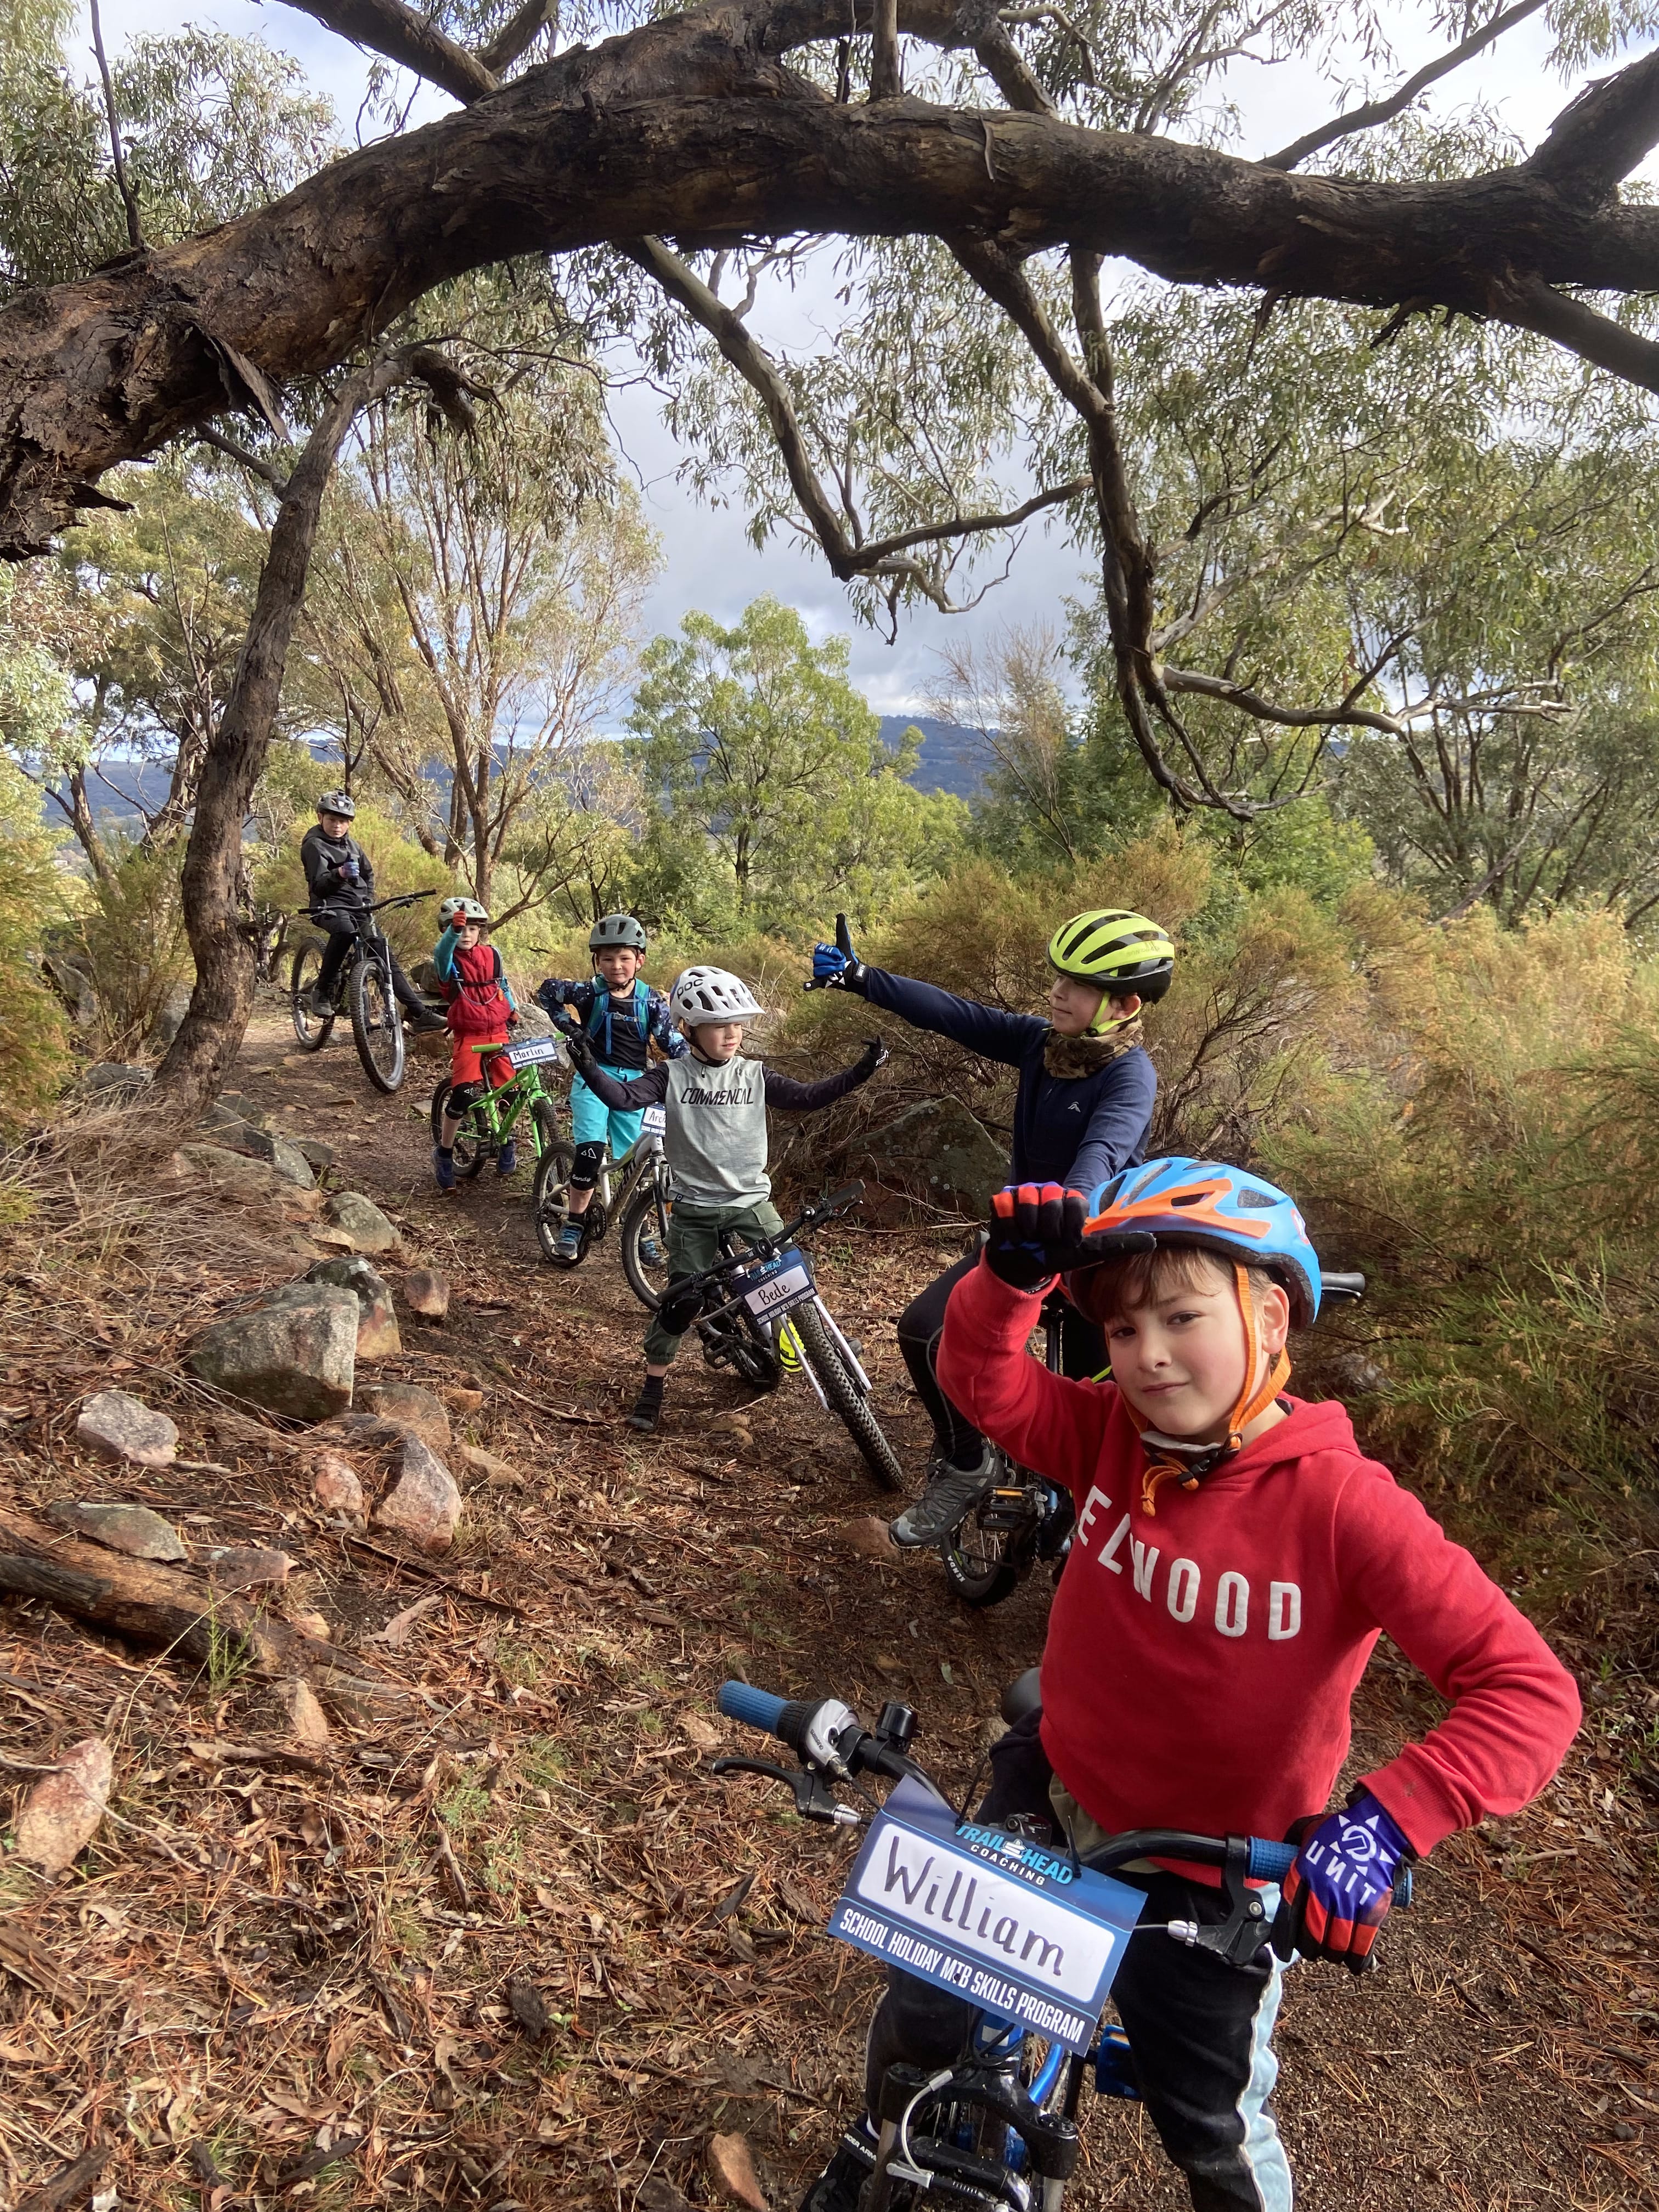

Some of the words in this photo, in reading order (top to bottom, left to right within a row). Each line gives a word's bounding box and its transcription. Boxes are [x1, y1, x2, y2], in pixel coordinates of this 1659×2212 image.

[514, 1048, 544, 1060] Marlin
[680, 1087, 754, 1106] COMMENCAL
[758, 1282, 791, 1306] Bede
[947, 1555, 966, 1582] KENDA
[1077, 1485, 1302, 1640] ELWOOD
[955, 1825, 1005, 1856] TRAIL
[1020, 1851, 1073, 1886] HEAD
[969, 1844, 1046, 1886] COACHING
[1305, 1840, 1378, 1906] UNIT
[884, 1836, 1064, 1977] William
[839, 1908, 887, 1949] SCHOOL
[887, 1929, 945, 1975] HOLIDAY
[940, 1956, 970, 1989] MTB
[970, 1970, 1014, 2010] SKILLS
[1015, 1991, 1086, 2044] PROGRAM
